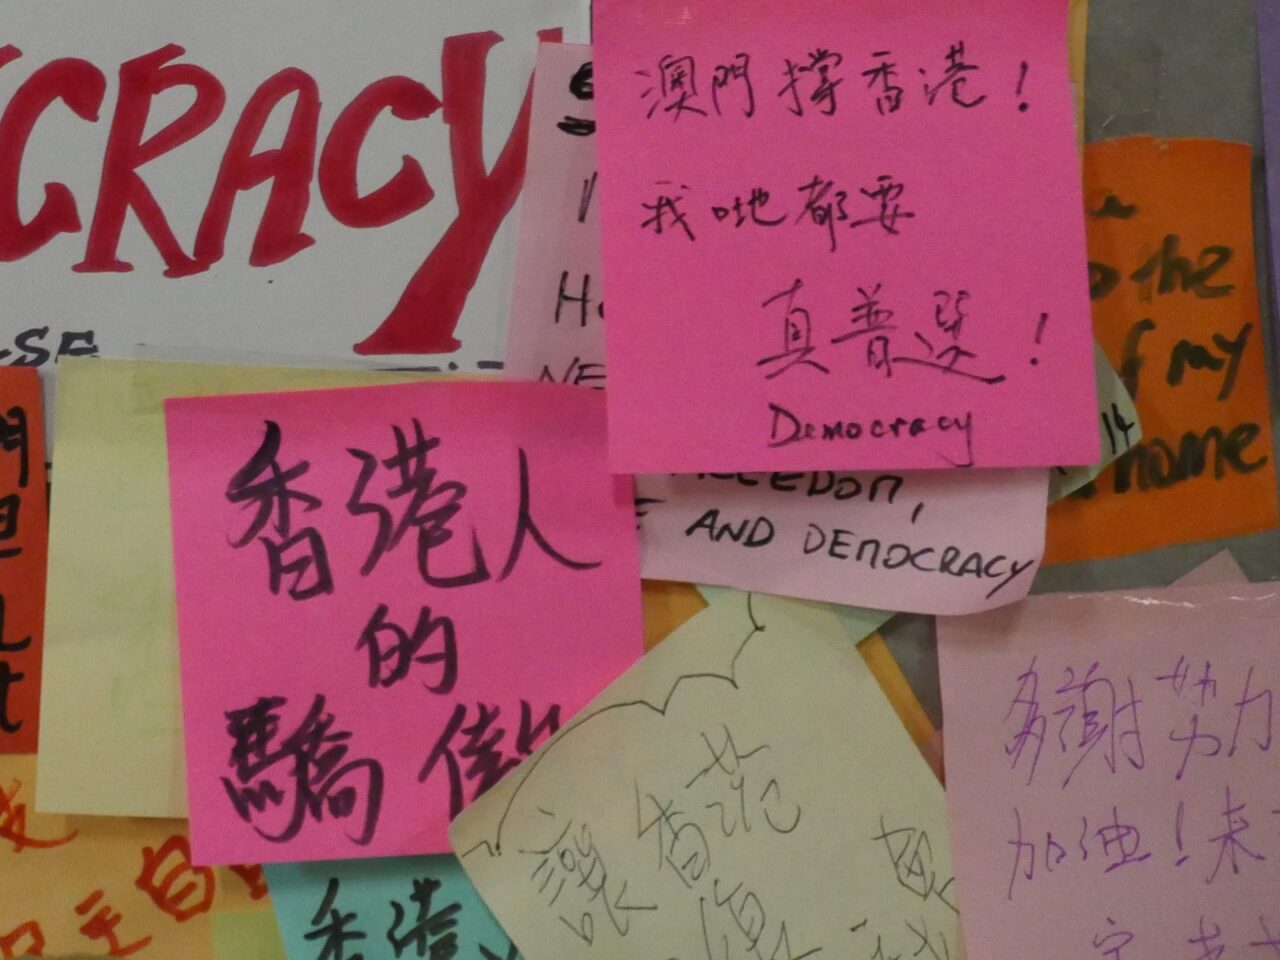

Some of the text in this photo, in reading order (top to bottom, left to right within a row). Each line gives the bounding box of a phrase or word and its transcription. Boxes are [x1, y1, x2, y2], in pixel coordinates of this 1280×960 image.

[767, 401, 976, 469] Democracy
[223, 417, 603, 603] 香港人
[684, 508, 777, 548] AND
[801, 522, 1037, 601] DEMOCRACY
[356, 604, 460, 696] 的
